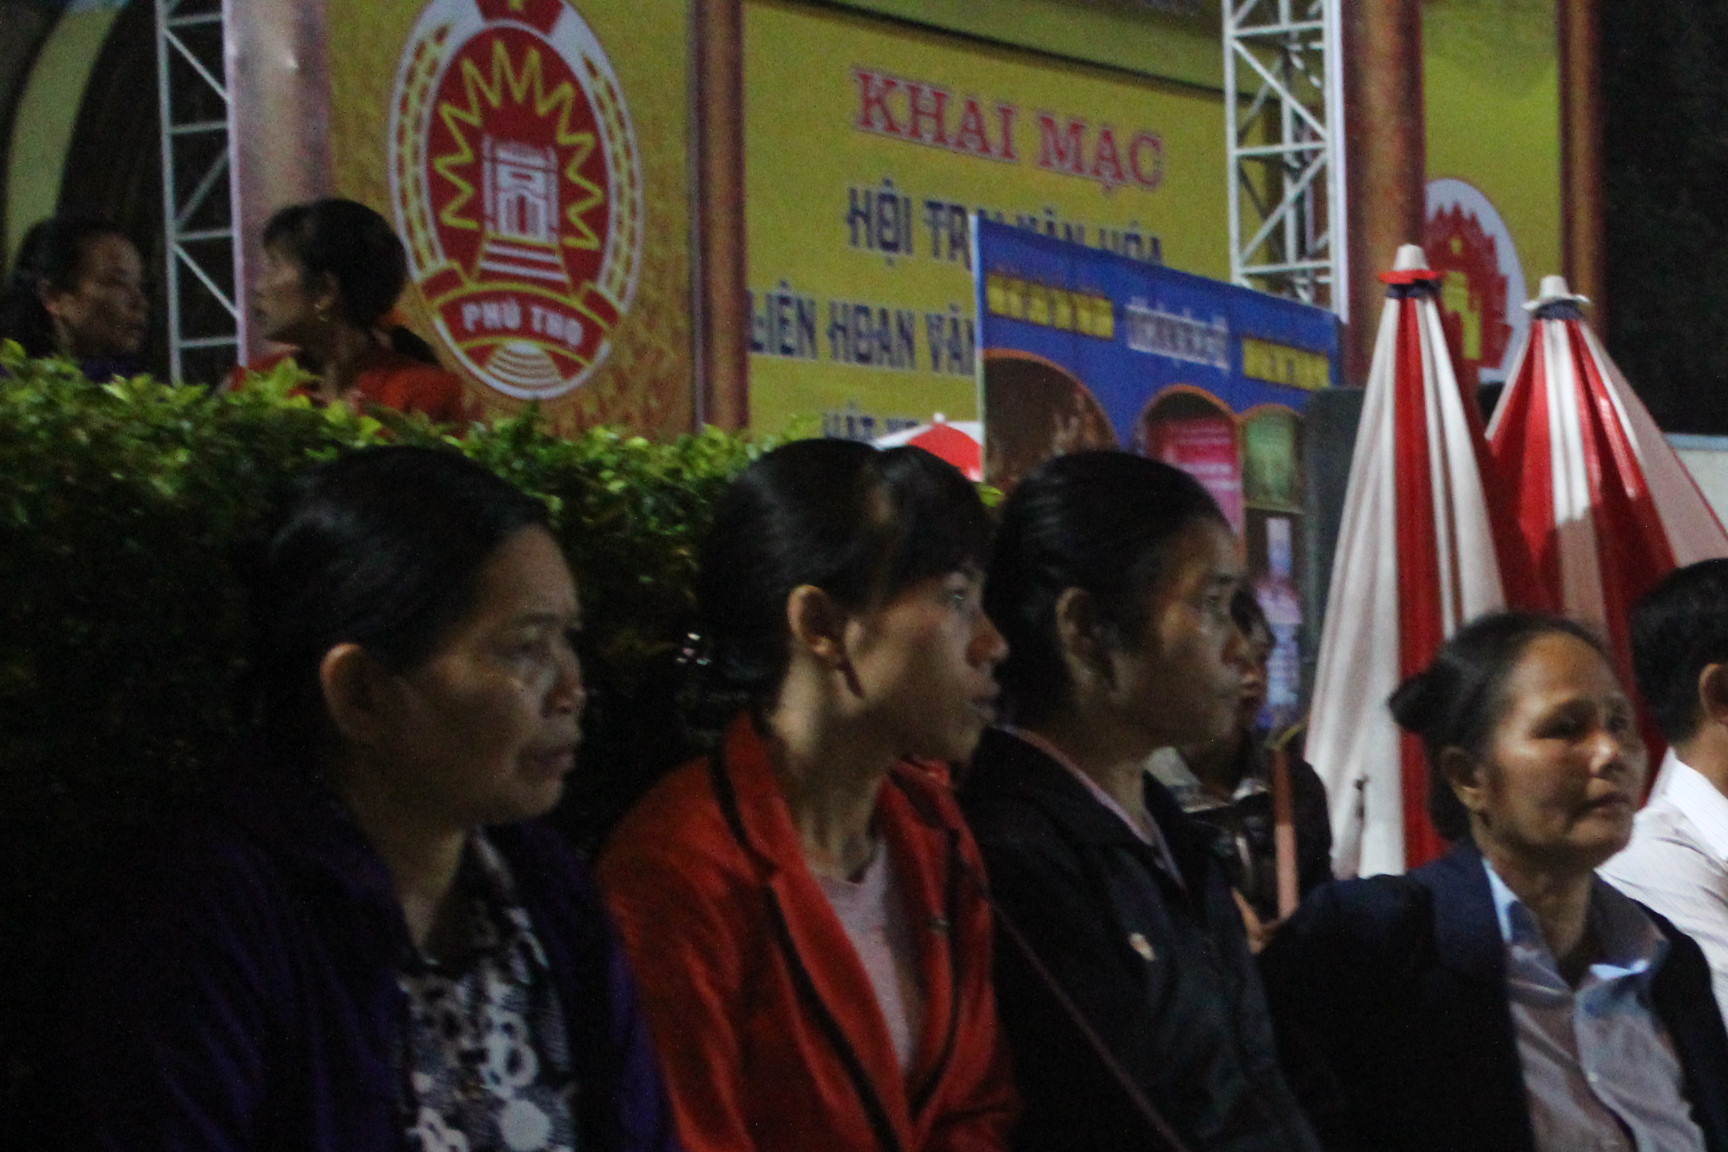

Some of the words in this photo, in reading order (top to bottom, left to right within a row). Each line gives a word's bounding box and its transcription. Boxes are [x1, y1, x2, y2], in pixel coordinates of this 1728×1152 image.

[856, 71, 1018, 161] KHAI
[1038, 114, 1163, 191] MẠC
[827, 300, 917, 370] HOAN
